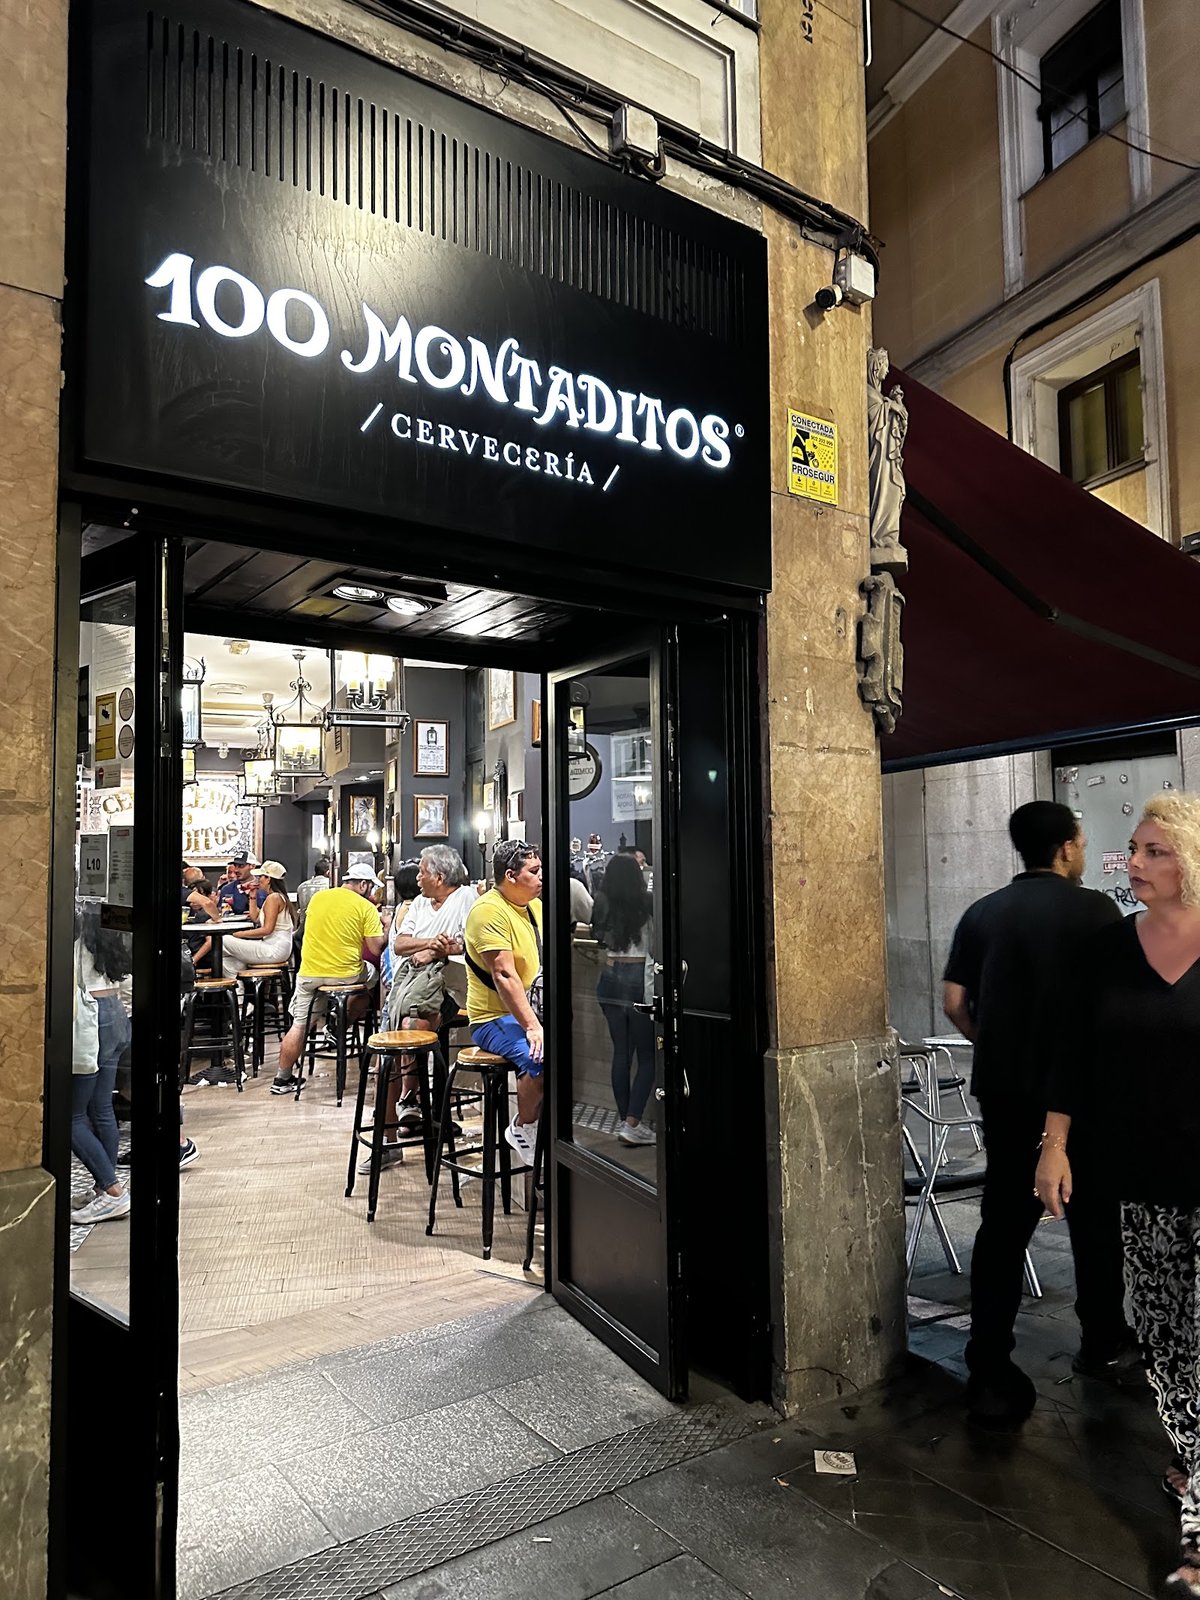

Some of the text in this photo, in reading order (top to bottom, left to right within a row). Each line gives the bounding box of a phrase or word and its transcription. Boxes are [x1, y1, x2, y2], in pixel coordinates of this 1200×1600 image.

[145, 252, 331, 358] 100
[791, 414, 834, 436] CONECTADA
[390, 413, 595, 485] CERVECERÍA
[791, 464, 835, 485] PROSEGUR
[86, 858, 101, 871] L10
